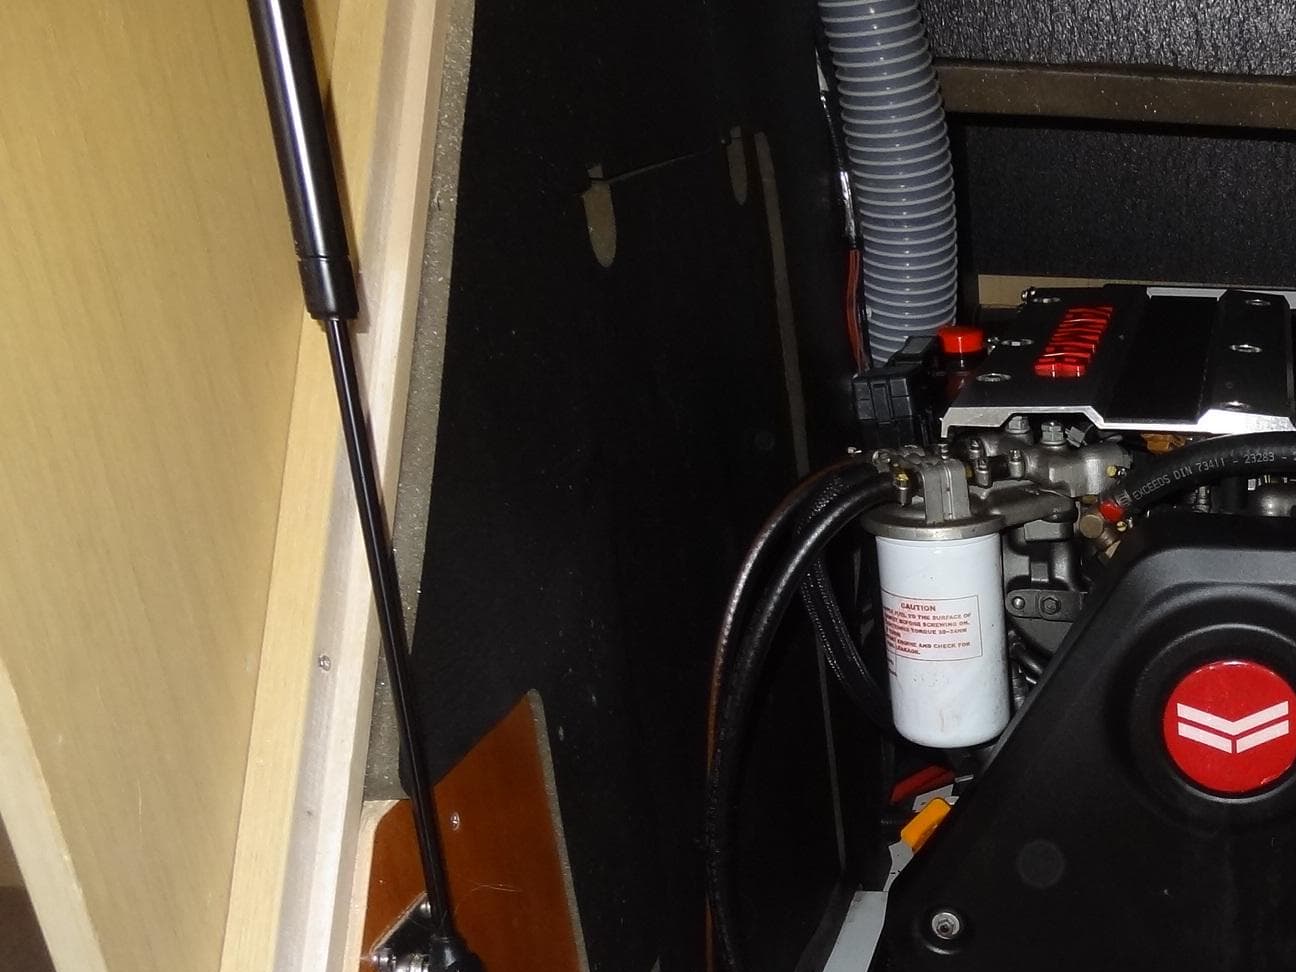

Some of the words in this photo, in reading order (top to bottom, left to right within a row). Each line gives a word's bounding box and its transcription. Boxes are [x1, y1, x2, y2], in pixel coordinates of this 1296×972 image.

[1133, 475, 1171, 501] EXCEEDS
[1173, 465, 1193, 480] DIN
[1196, 457, 1225, 472] 73411
[900, 602, 936, 611] CAUTION
